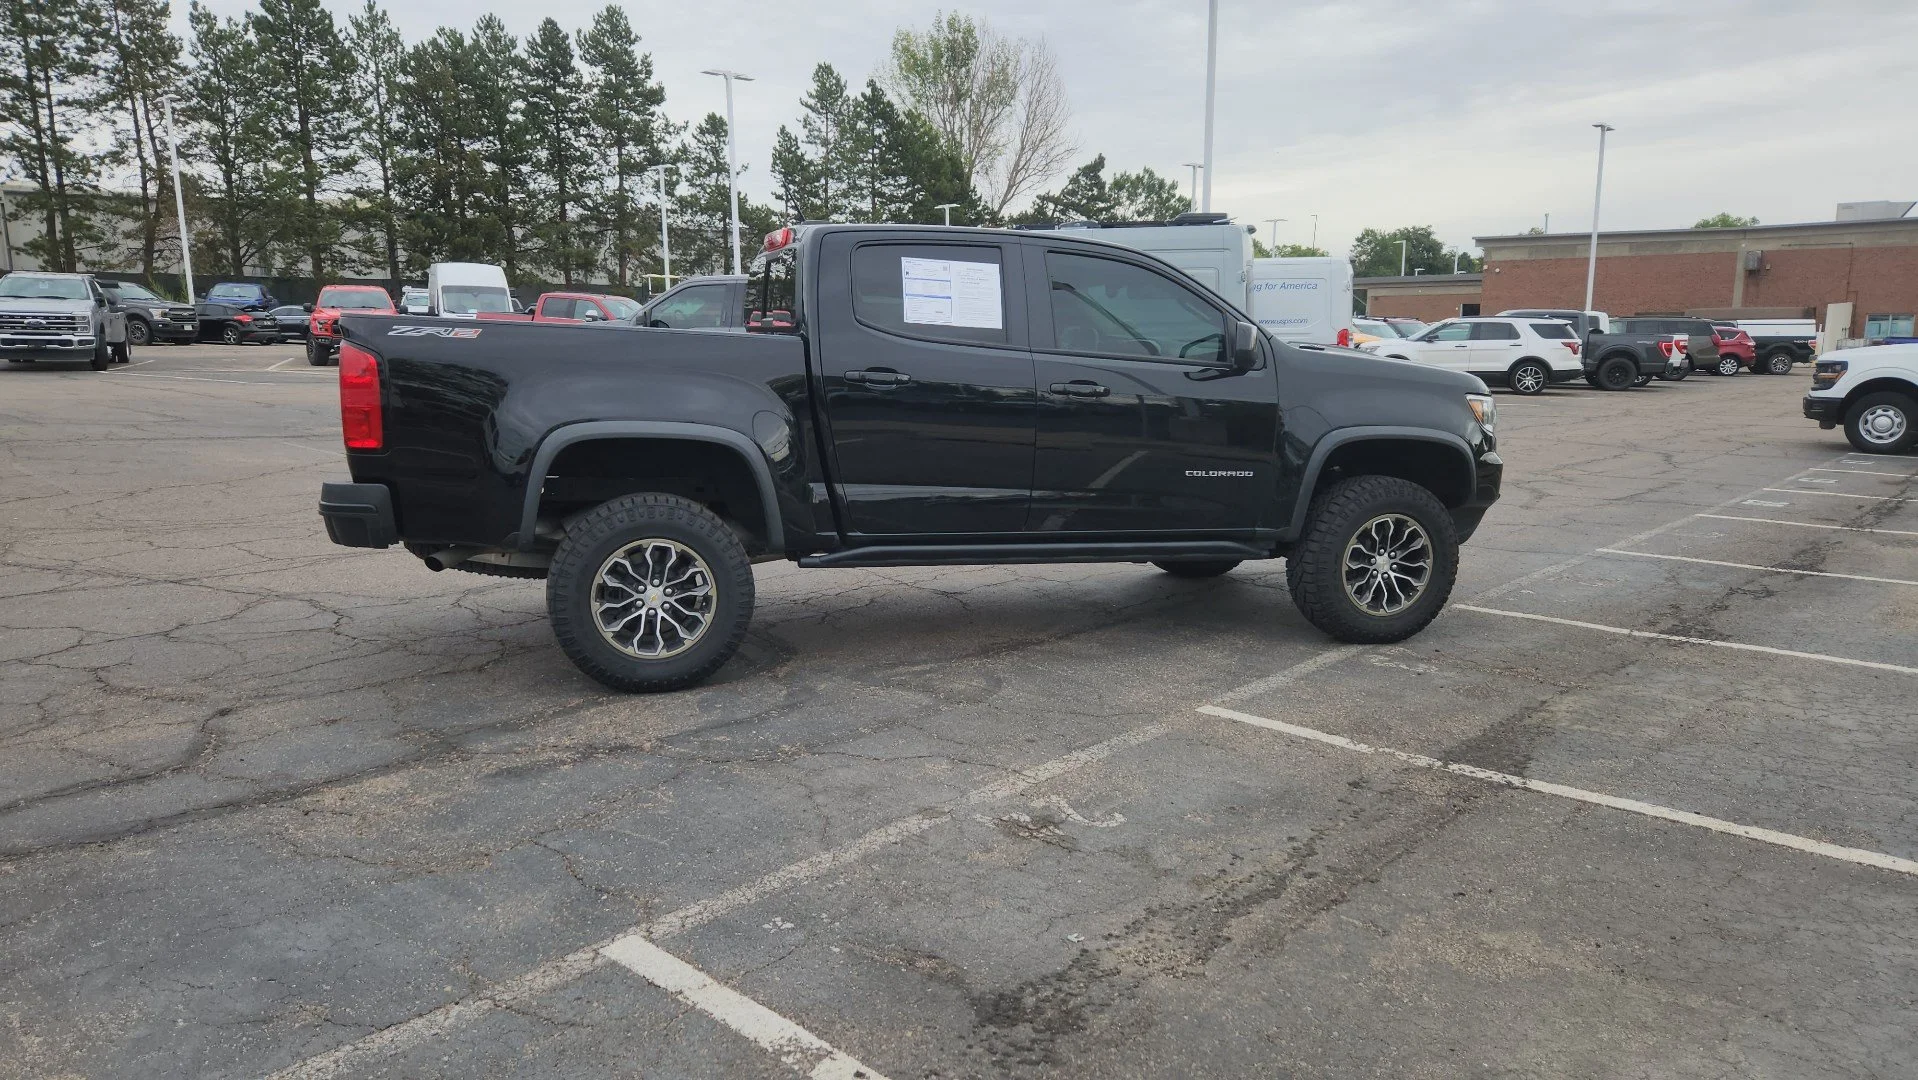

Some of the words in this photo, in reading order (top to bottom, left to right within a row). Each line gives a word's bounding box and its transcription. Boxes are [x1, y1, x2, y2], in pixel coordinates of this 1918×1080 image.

[1264, 282, 1278, 290] for
[1279, 281, 1318, 290] America
[387, 325, 483, 339] ZR2
